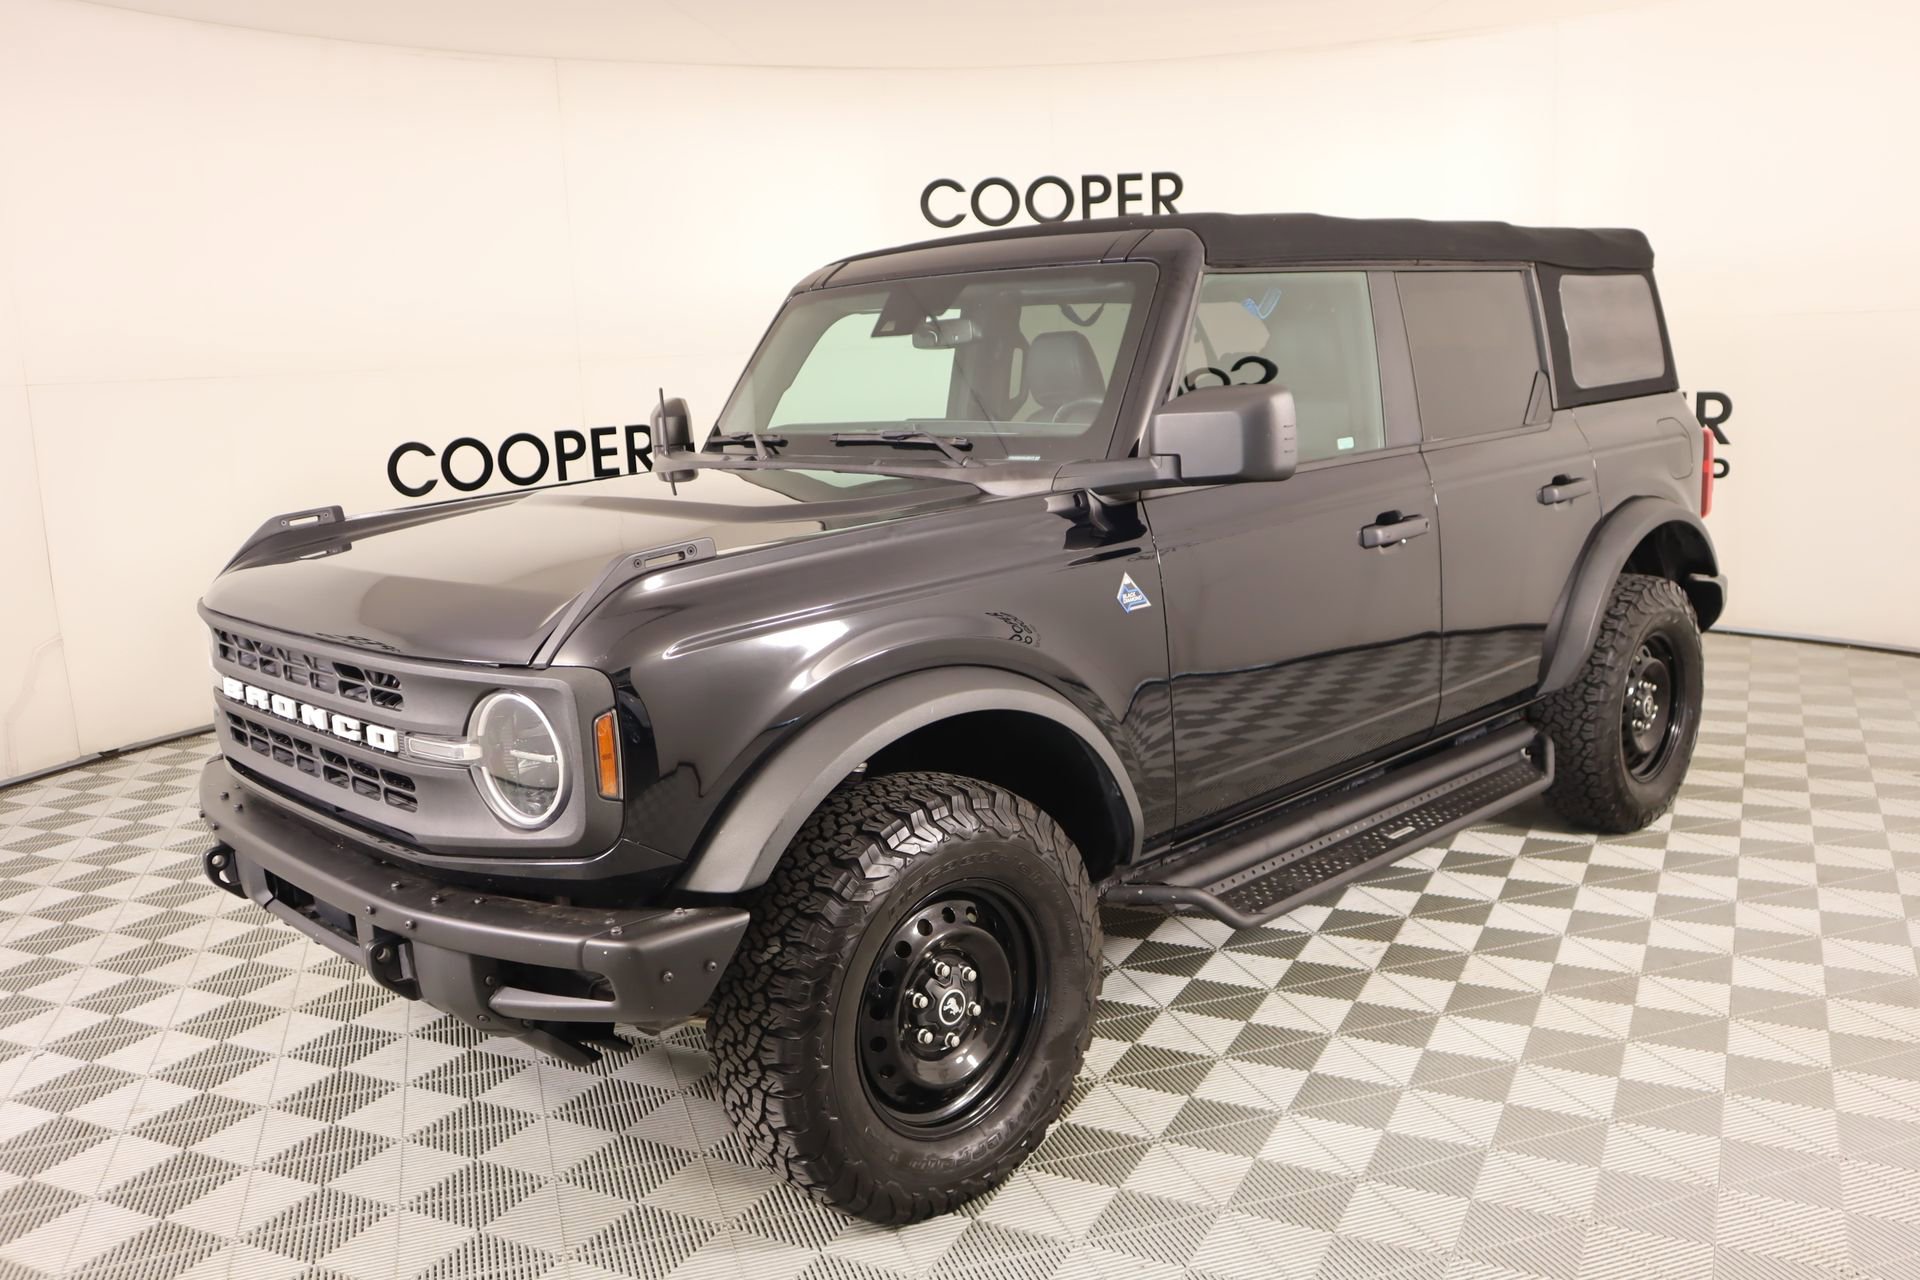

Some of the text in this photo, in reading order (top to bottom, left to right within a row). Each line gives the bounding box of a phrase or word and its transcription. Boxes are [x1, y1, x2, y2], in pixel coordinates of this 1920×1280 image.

[919, 171, 1184, 228] COOPER
[387, 424, 654, 497] COOPER
[223, 676, 399, 752] BRONCO
